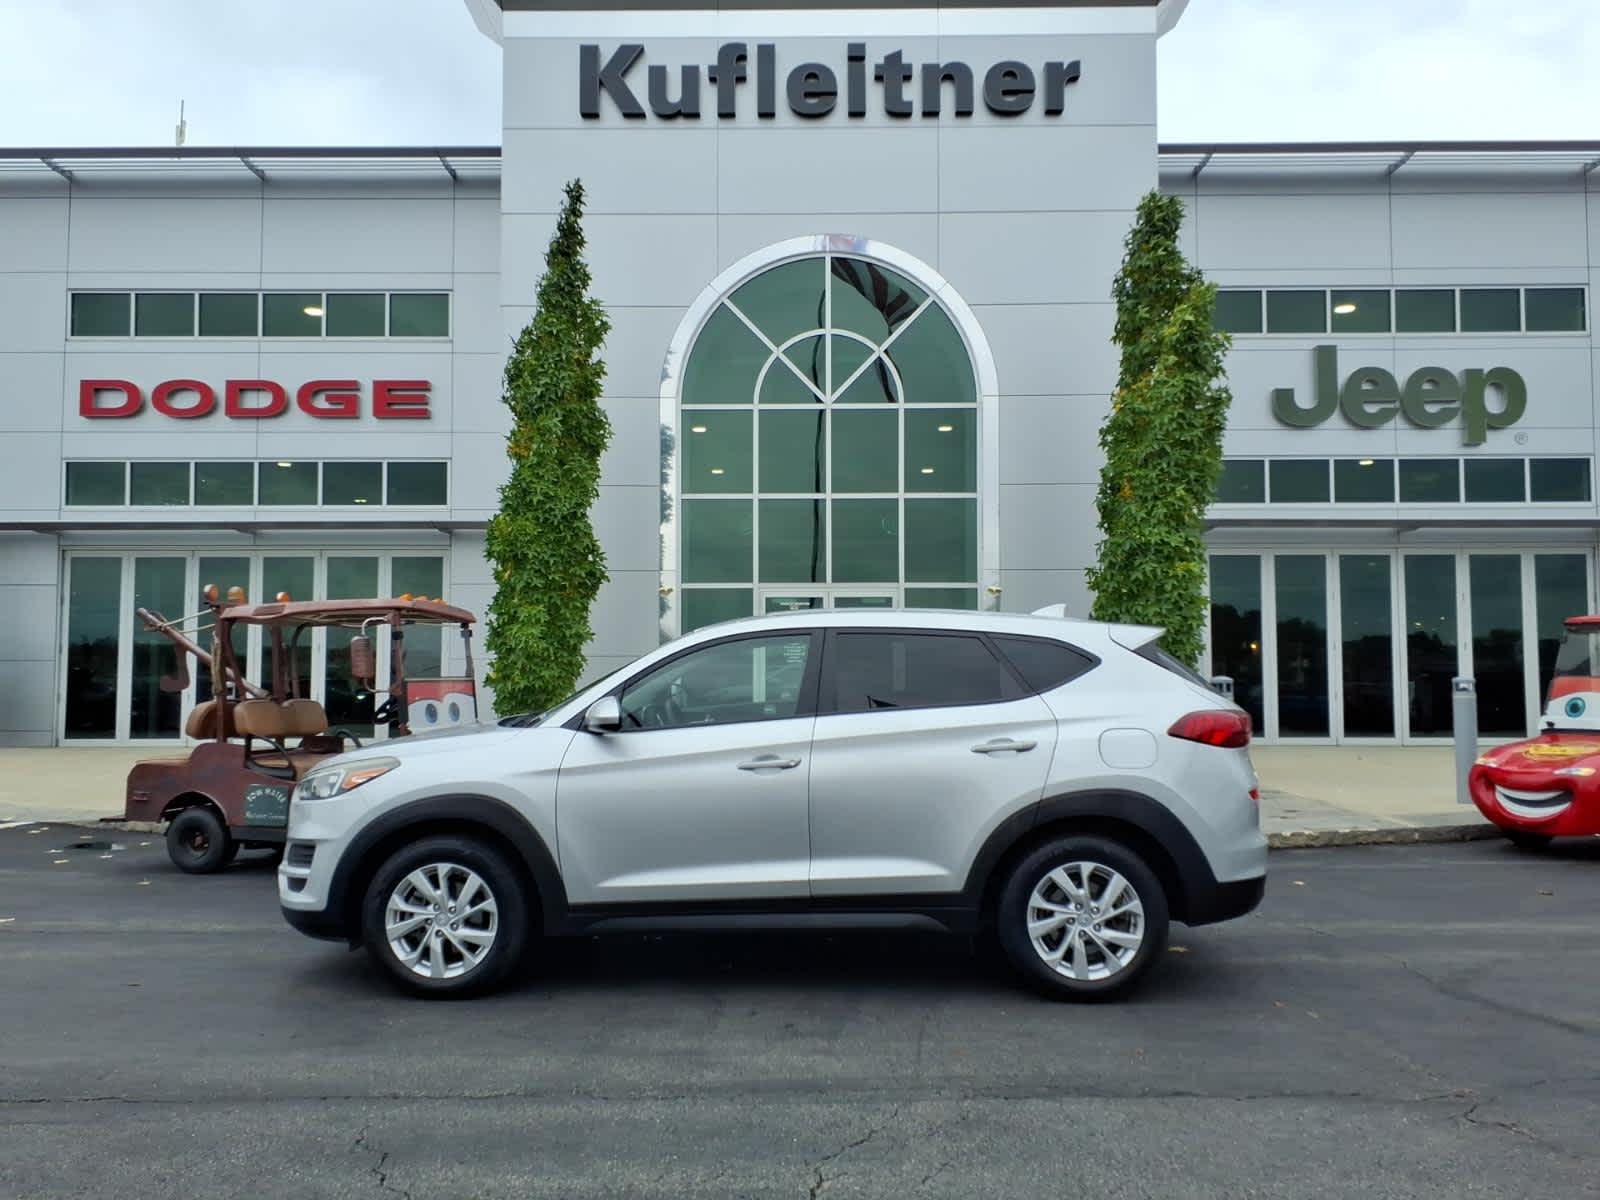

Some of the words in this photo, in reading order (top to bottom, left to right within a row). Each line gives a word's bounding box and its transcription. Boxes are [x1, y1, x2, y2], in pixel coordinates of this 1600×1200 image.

[580, 42, 1081, 119] Kufleitner
[79, 379, 432, 420] DODGE
[1272, 345, 1527, 447] Jeep
